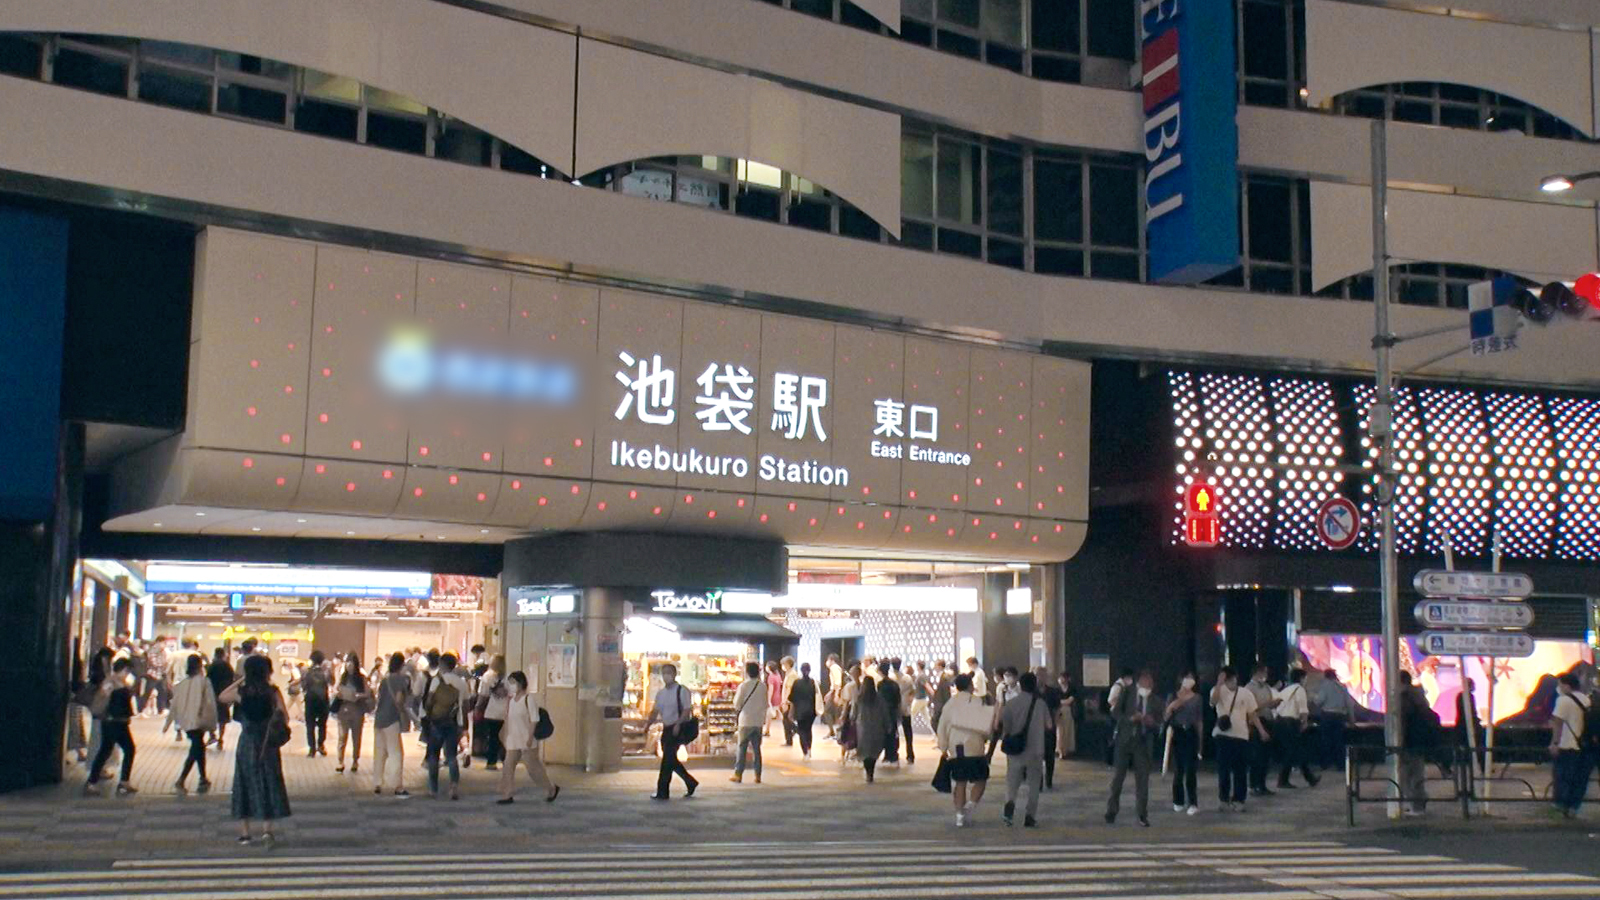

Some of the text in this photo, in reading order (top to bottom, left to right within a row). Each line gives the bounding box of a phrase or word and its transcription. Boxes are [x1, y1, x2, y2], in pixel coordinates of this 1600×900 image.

[614, 351, 827, 442] 池袋駅
[872, 398, 938, 442] 東口
[611, 440, 849, 486] Ikebukuro Station
[871, 440, 971, 466] East Entrance
